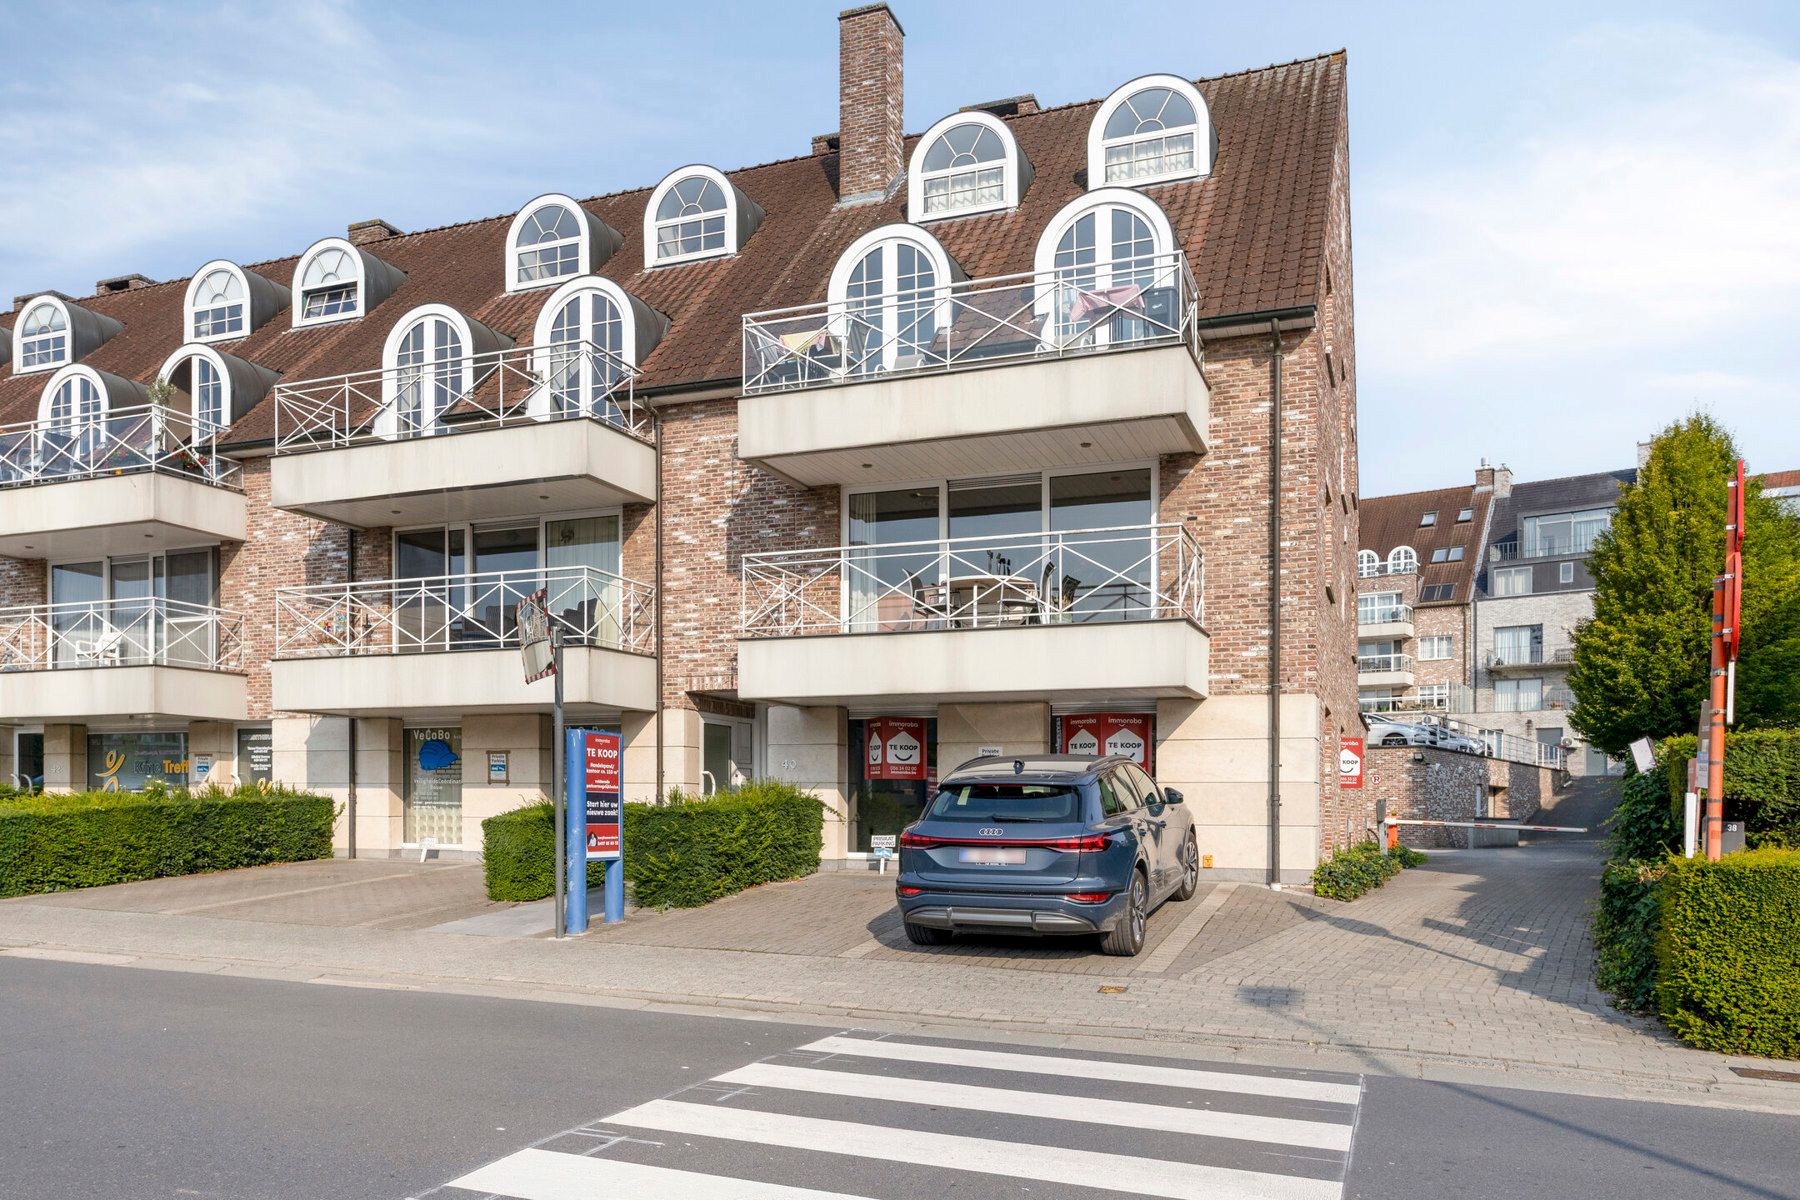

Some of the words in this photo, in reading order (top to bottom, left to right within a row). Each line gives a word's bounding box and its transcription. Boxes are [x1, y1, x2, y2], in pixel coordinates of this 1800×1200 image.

[889, 720, 918, 728] immoroba
[413, 729, 450, 740] VeCoBo
[586, 747, 596, 757] TE
[597, 748, 618, 758] KOOP
[586, 800, 599, 808] Start
[600, 800, 609, 808] hier
[586, 808, 604, 816] nieuwe
[1727, 824, 1737, 832] 38
